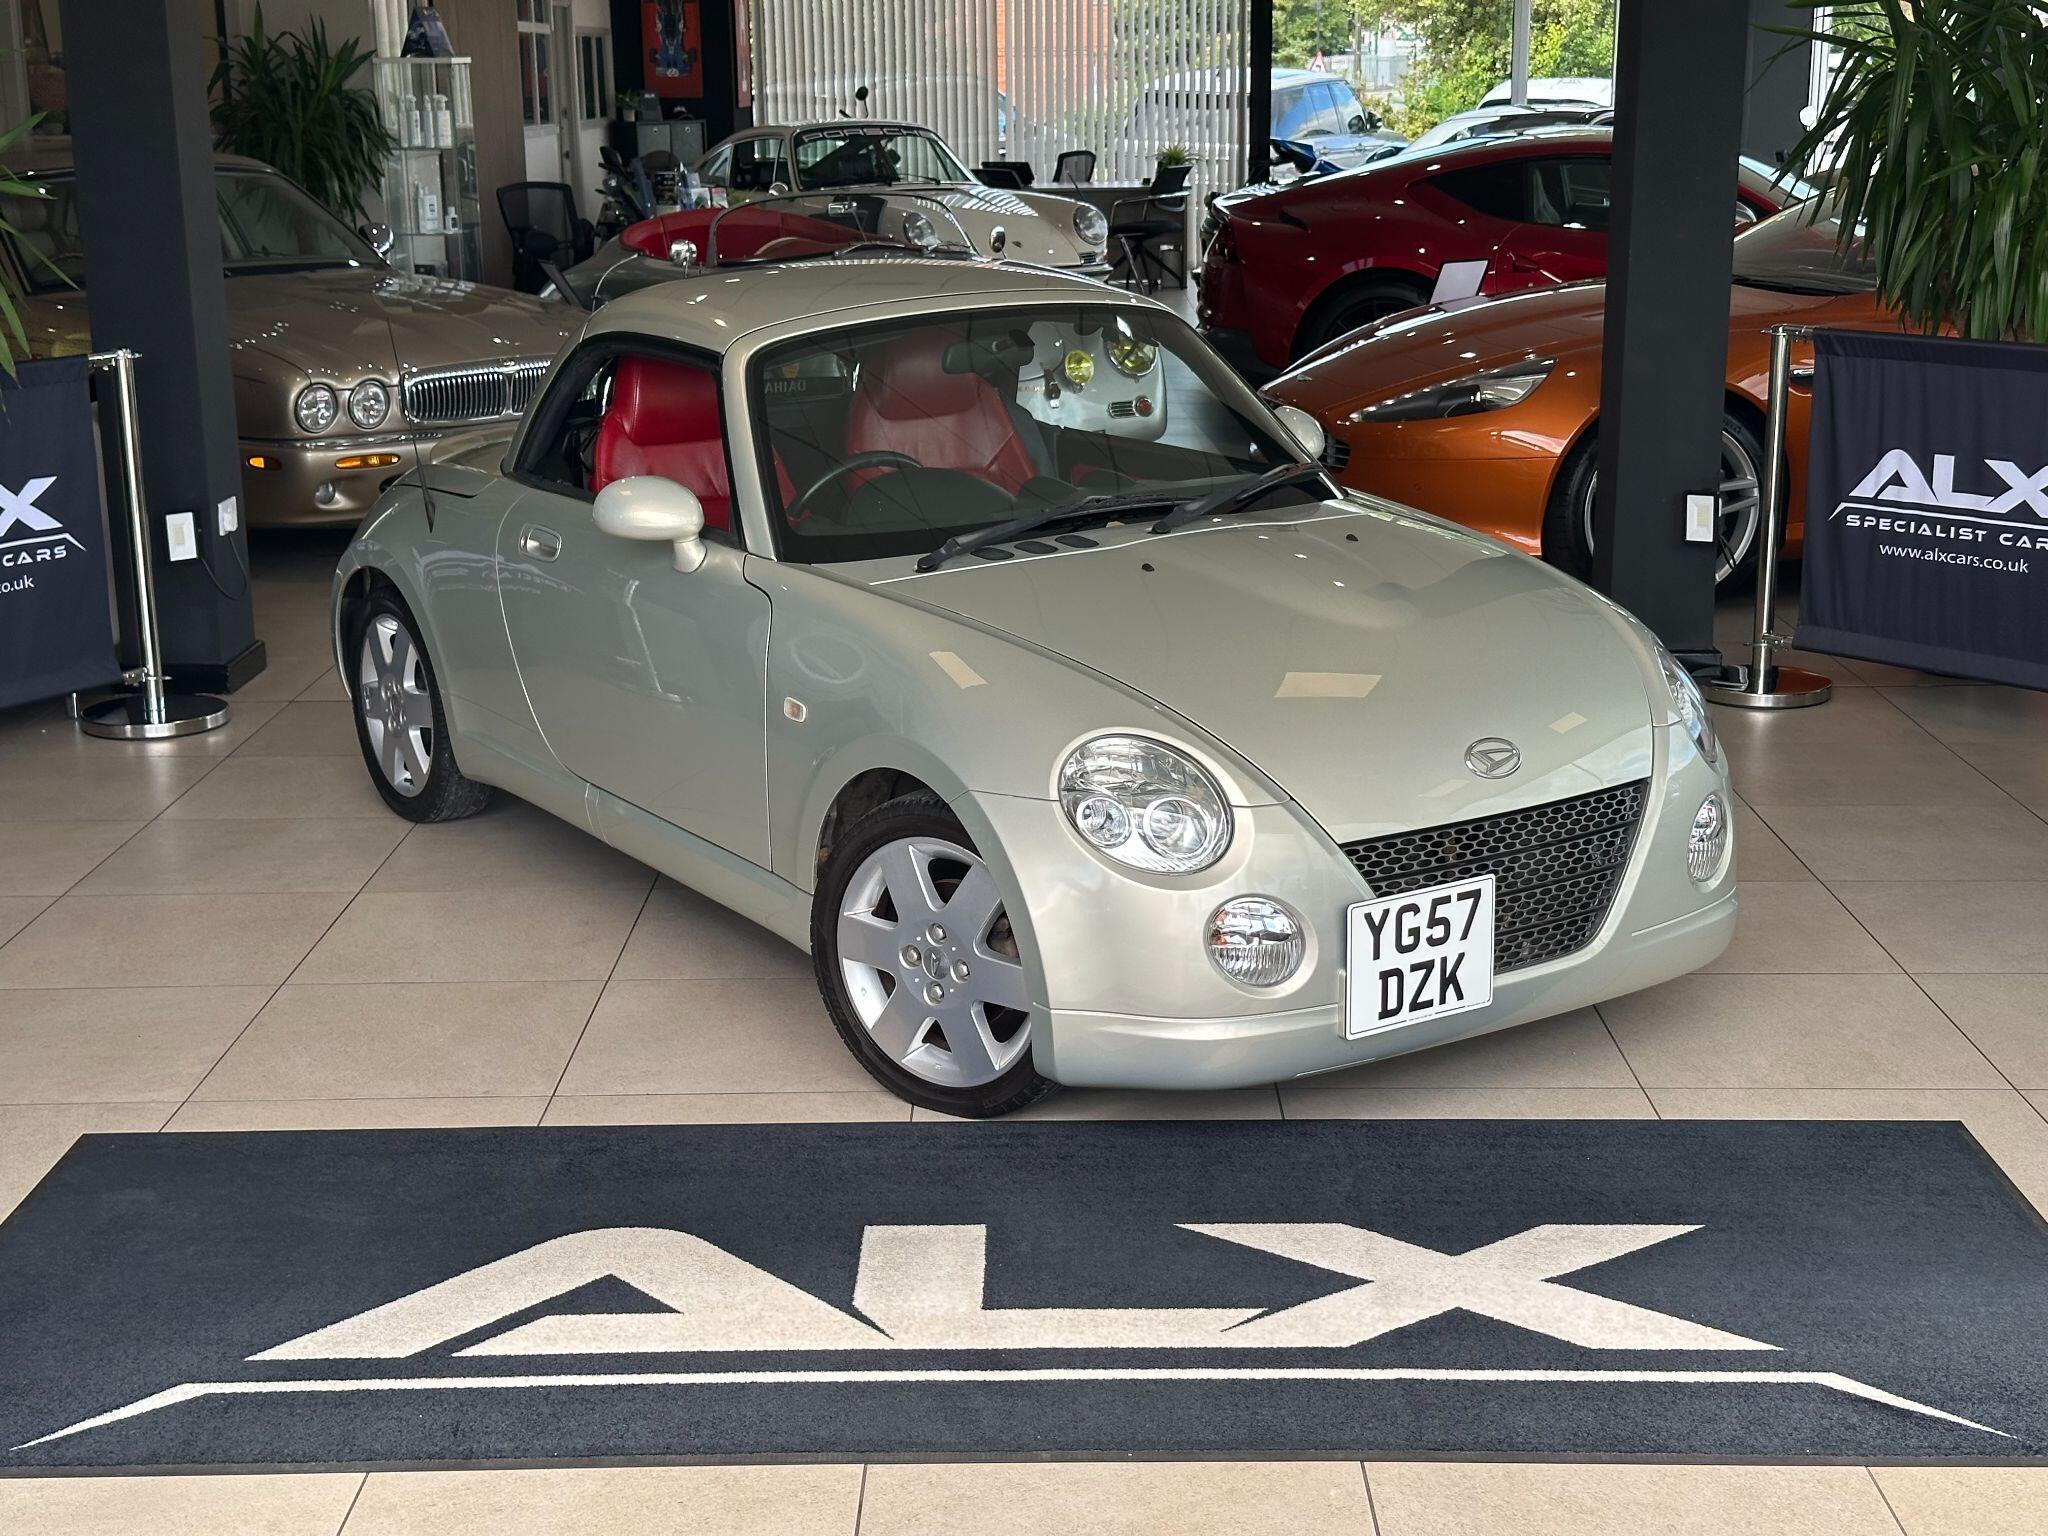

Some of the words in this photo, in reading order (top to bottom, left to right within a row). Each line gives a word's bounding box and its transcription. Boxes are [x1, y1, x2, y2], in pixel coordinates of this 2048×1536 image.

[0, 475, 63, 538] X
[1848, 448, 2048, 518] ALX
[2, 544, 67, 567] CARS
[1845, 514, 1988, 542] SPECIALIST
[1999, 533, 2048, 550] CAR
[1879, 544, 2029, 573] www.alxcars.co.uk
[0, 574, 35, 593] o.uk
[1363, 888, 1482, 961] YG57
[1378, 951, 1466, 1020] DZK
[244, 1222, 1784, 1361] ALX
